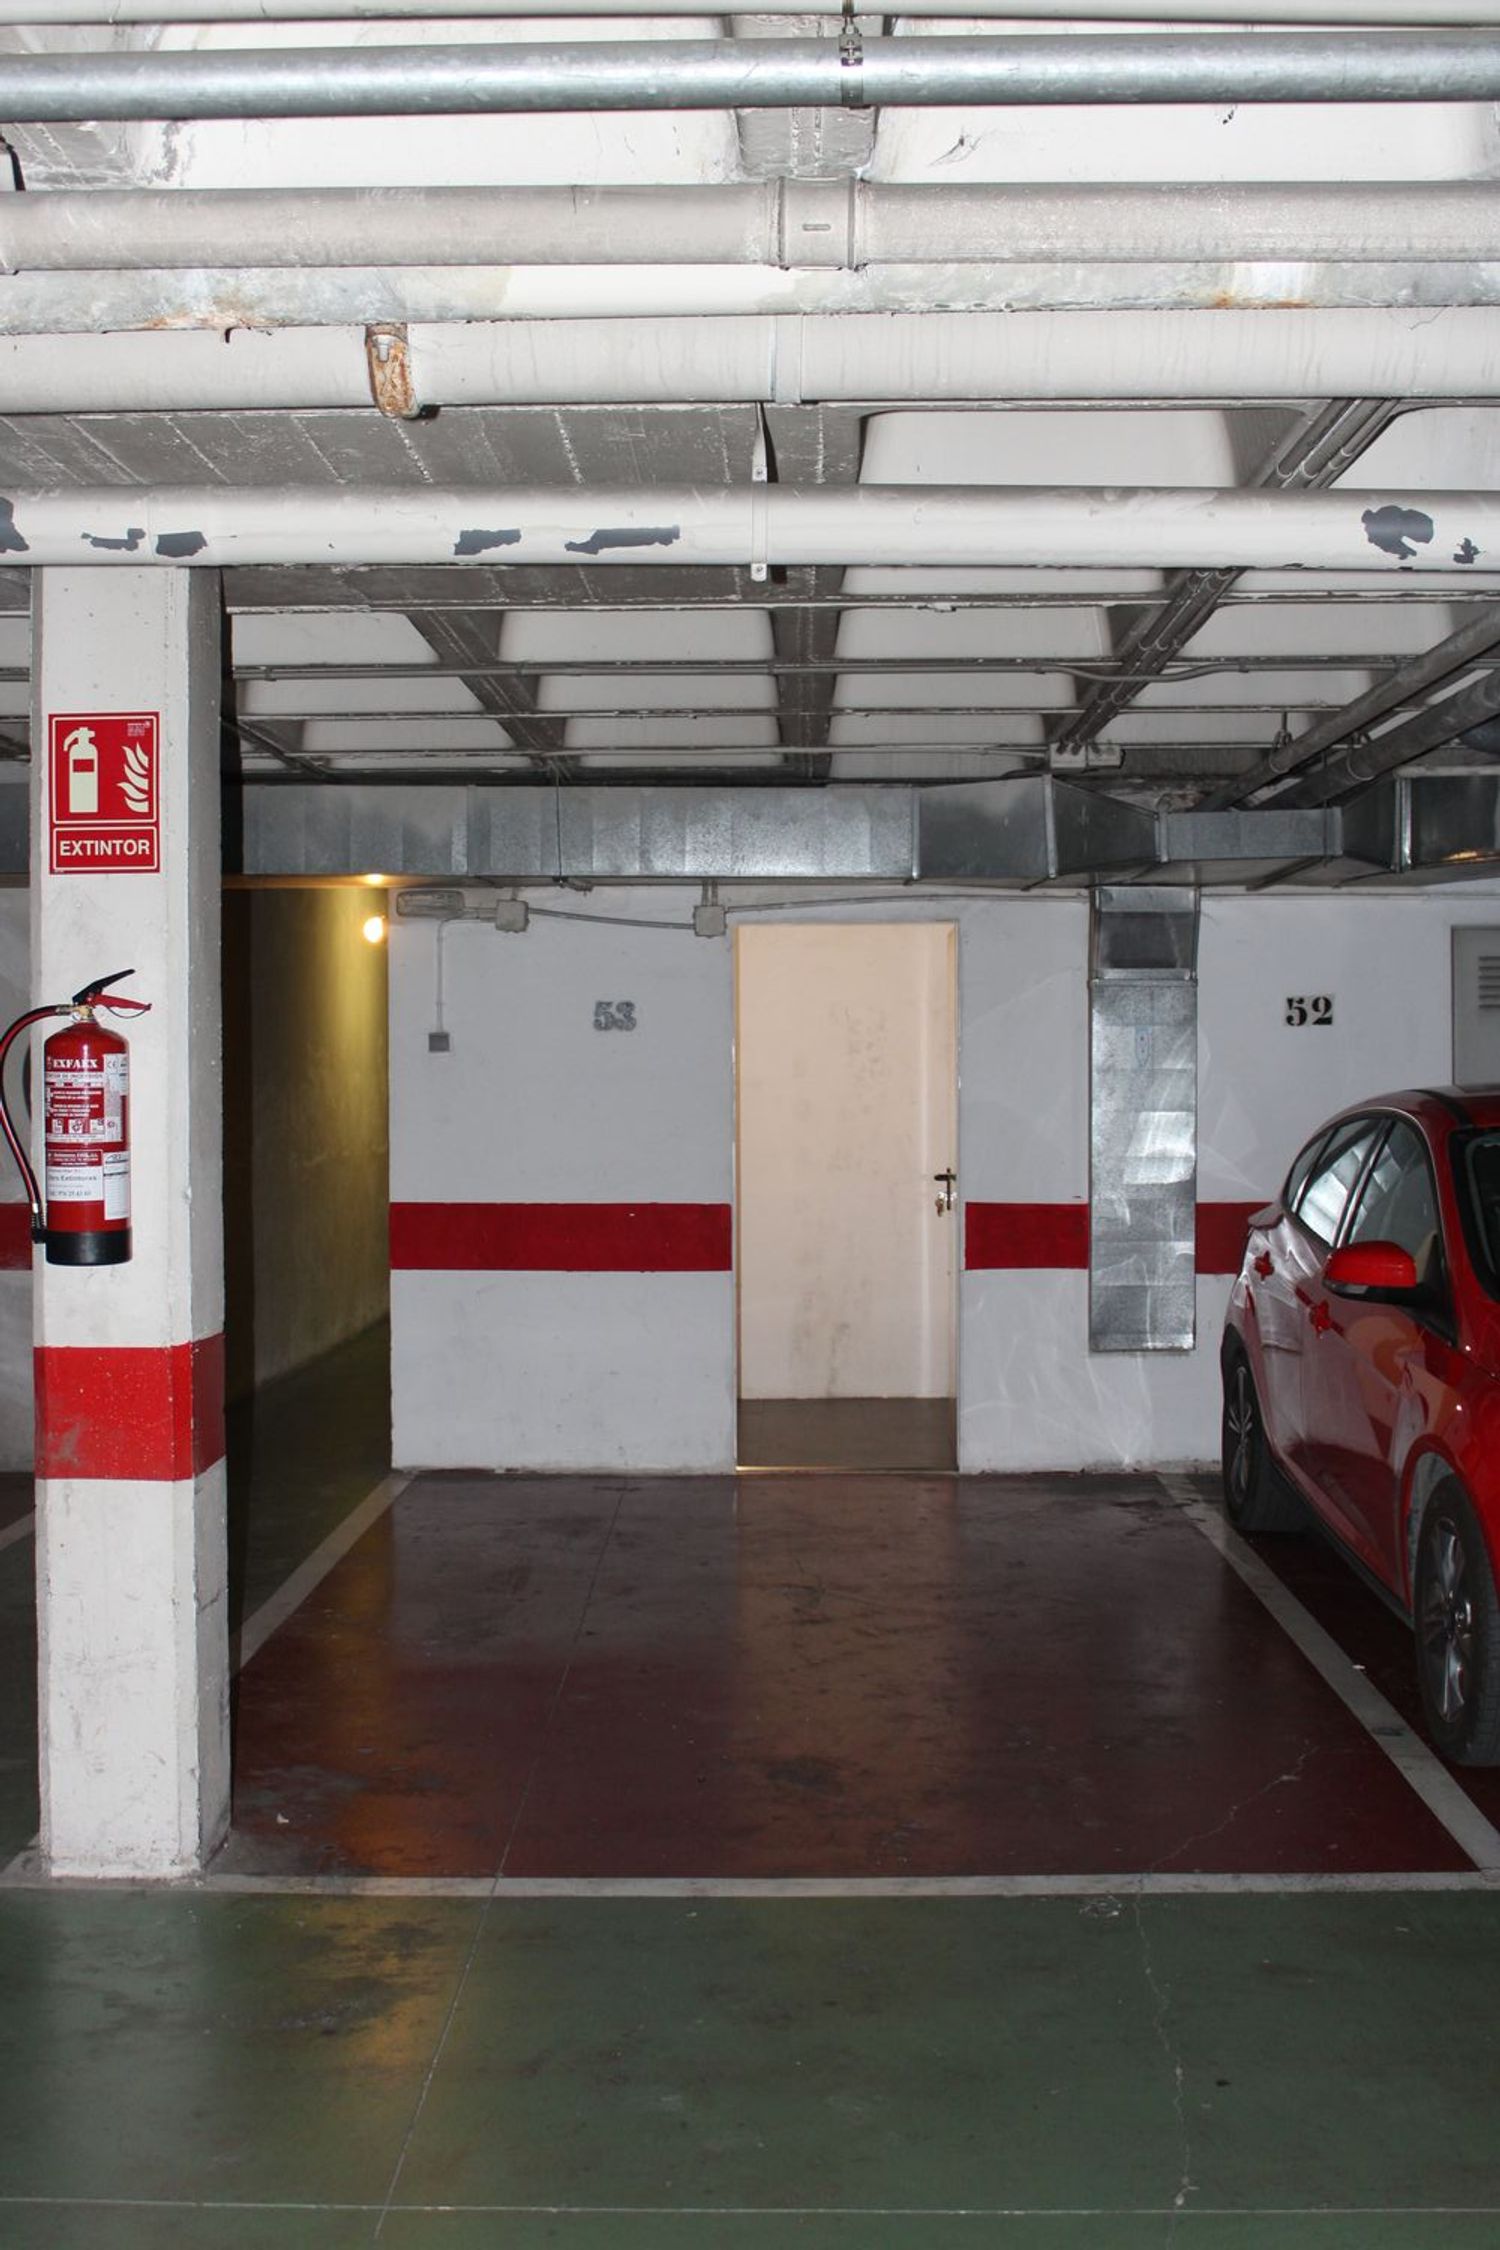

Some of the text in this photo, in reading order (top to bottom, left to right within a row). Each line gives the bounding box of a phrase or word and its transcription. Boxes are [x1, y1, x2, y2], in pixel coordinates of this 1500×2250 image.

[59, 839, 150, 857] EXTINTOR
[593, 1001, 637, 1031] 53
[1286, 996, 1333, 1026] 52
